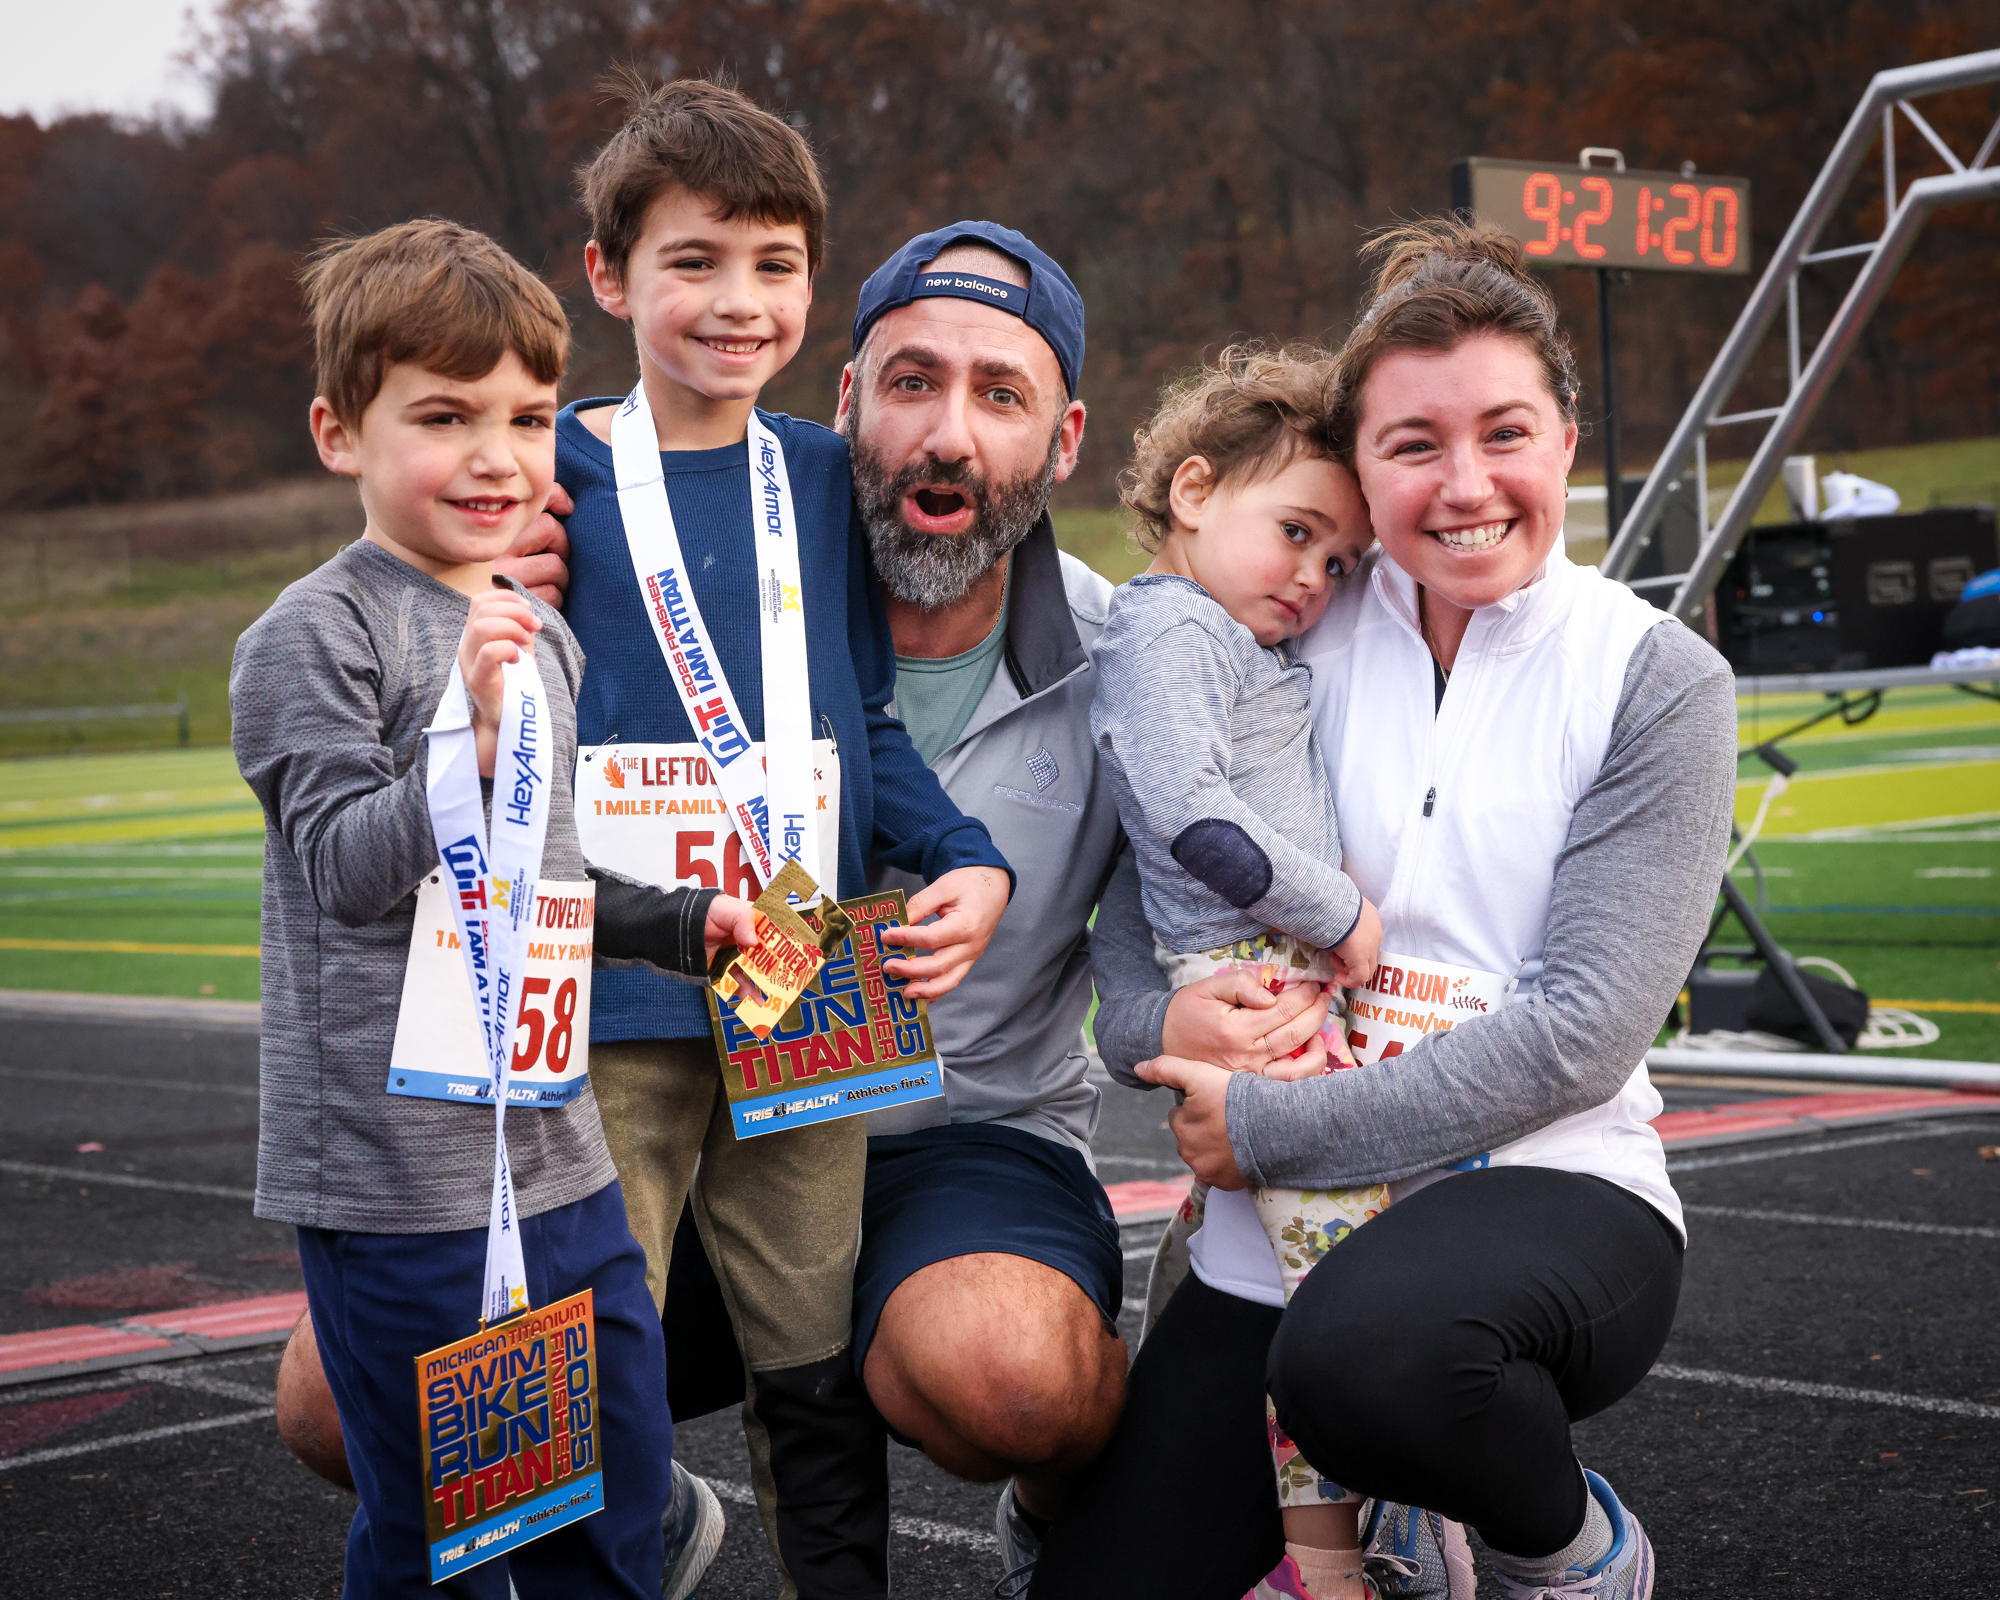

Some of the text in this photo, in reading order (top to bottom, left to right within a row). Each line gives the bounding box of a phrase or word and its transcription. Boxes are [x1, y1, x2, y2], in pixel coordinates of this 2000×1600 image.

[926, 278, 1008, 299] new balance
[756, 436, 783, 538] HexArmor
[646, 574, 699, 699] 2025 FINISHER
[656, 567, 717, 694] I AM A TITAN
[505, 689, 543, 827] HexArmor
[621, 756, 717, 786] THE LEFTO
[594, 799, 728, 816] 1 MILE FAMILY
[993, 783, 1044, 804] SPECTRUM
[436, 929, 444, 947] 1
[536, 895, 582, 930] TOVER
[755, 915, 808, 977] LEFTOVER
[467, 929, 487, 970] AM
[475, 971, 489, 991] A
[527, 942, 568, 961] MILY
[749, 943, 778, 977] RUN
[855, 924, 898, 1062] FINISHER
[873, 919, 926, 1057] 2025
[1404, 969, 1449, 1006] RUN
[511, 976, 578, 1074] 58
[729, 1024, 876, 1092] TITAN
[846, 1083, 898, 1102] Athletes
[900, 1075, 931, 1091] first.
[426, 1302, 587, 1380] MICHIGAN TITANIUM
[427, 1339, 547, 1413] SWIM
[428, 1368, 549, 1452] BIKE
[549, 1330, 572, 1480] FINISHER
[564, 1322, 596, 1472] 2025
[431, 1403, 552, 1491] RUN
[433, 1441, 554, 1530] TITAN
[525, 1501, 568, 1528] Athletes
[570, 1490, 594, 1508] first.
